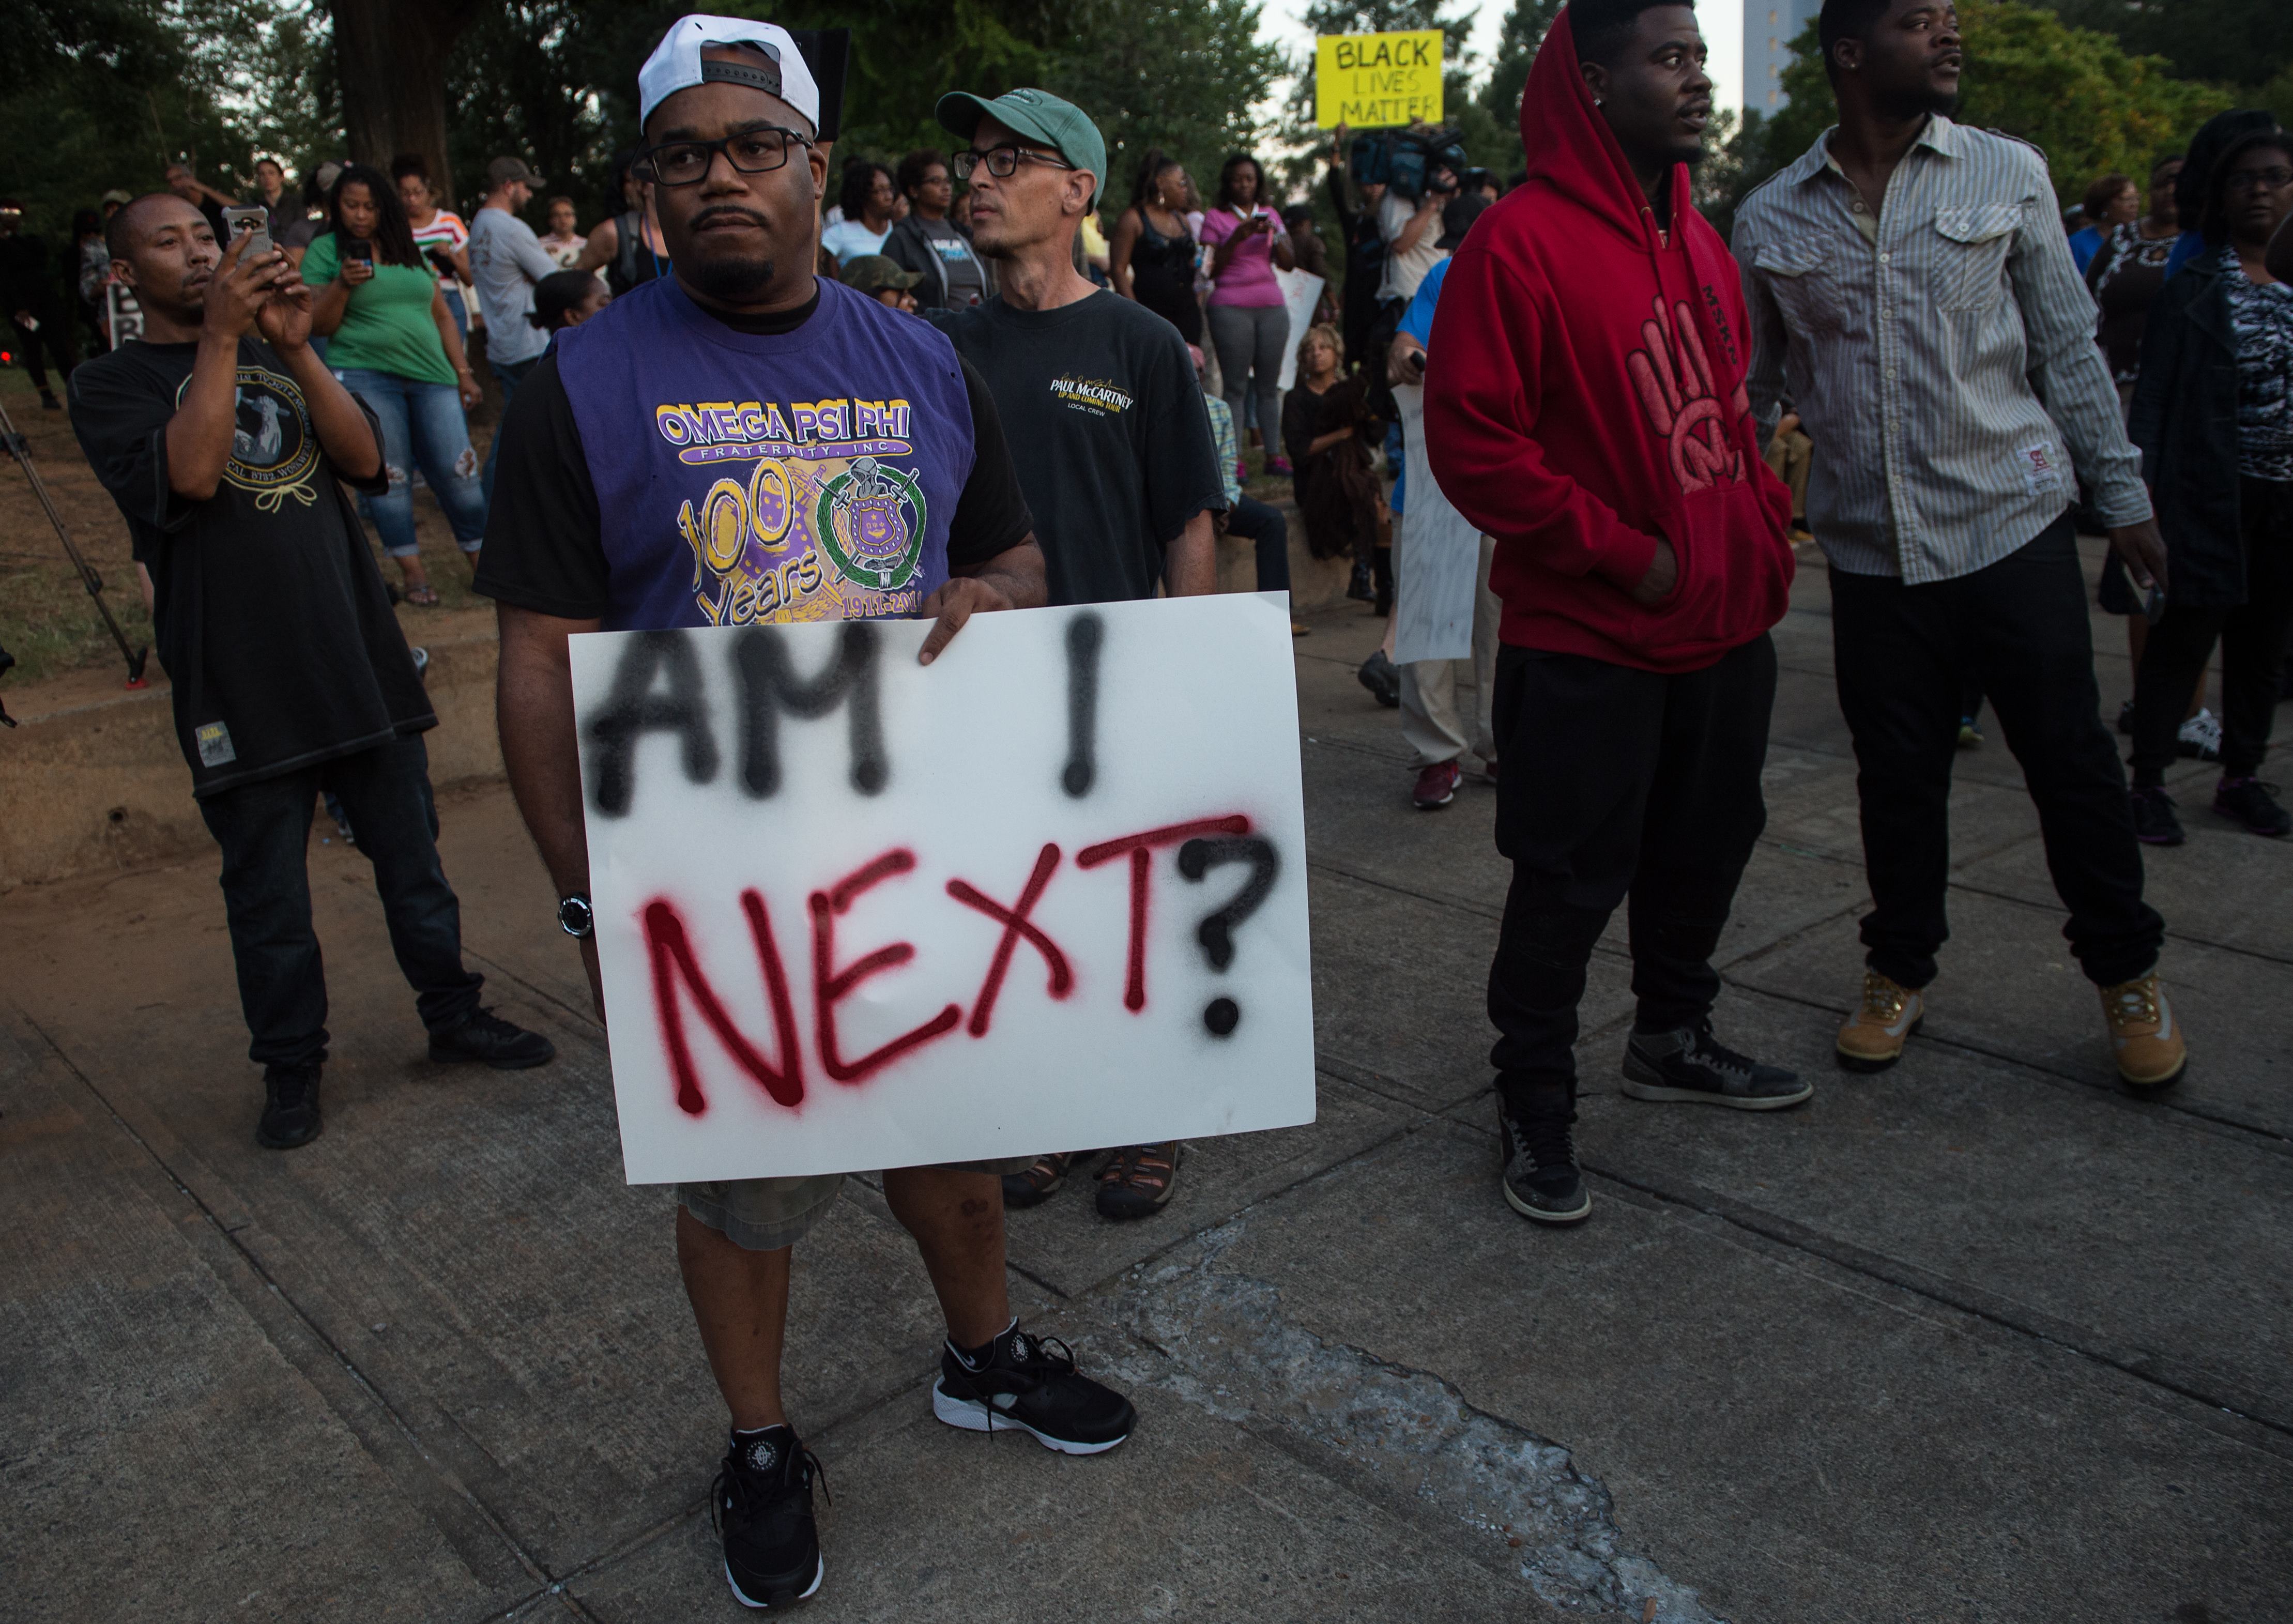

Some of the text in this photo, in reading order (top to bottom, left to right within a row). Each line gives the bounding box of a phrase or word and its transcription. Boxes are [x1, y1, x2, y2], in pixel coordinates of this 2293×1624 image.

[1335, 39, 1430, 69] BLACK
[1352, 69, 1421, 95] LIVES
[1340, 94, 1438, 123] MATTER
[1050, 379, 1075, 393] PAUL
[1076, 382, 1134, 410] McCARTNEY
[1066, 392, 1080, 402] AND
[1081, 396, 1104, 407] COMING
[1105, 402, 1121, 413] TOUR
[656, 397, 911, 446] OMEGA PSI PHI
[1067, 403, 1106, 417] LOCAL CREW
[700, 441, 897, 461] FRATERNITY, INC.
[677, 457, 796, 592] 100
[696, 550, 824, 626] Years
[841, 590, 922, 619] 1911-2011
[589, 611, 1105, 817] AM I
[641, 813, 1280, 1118] NEXT?
